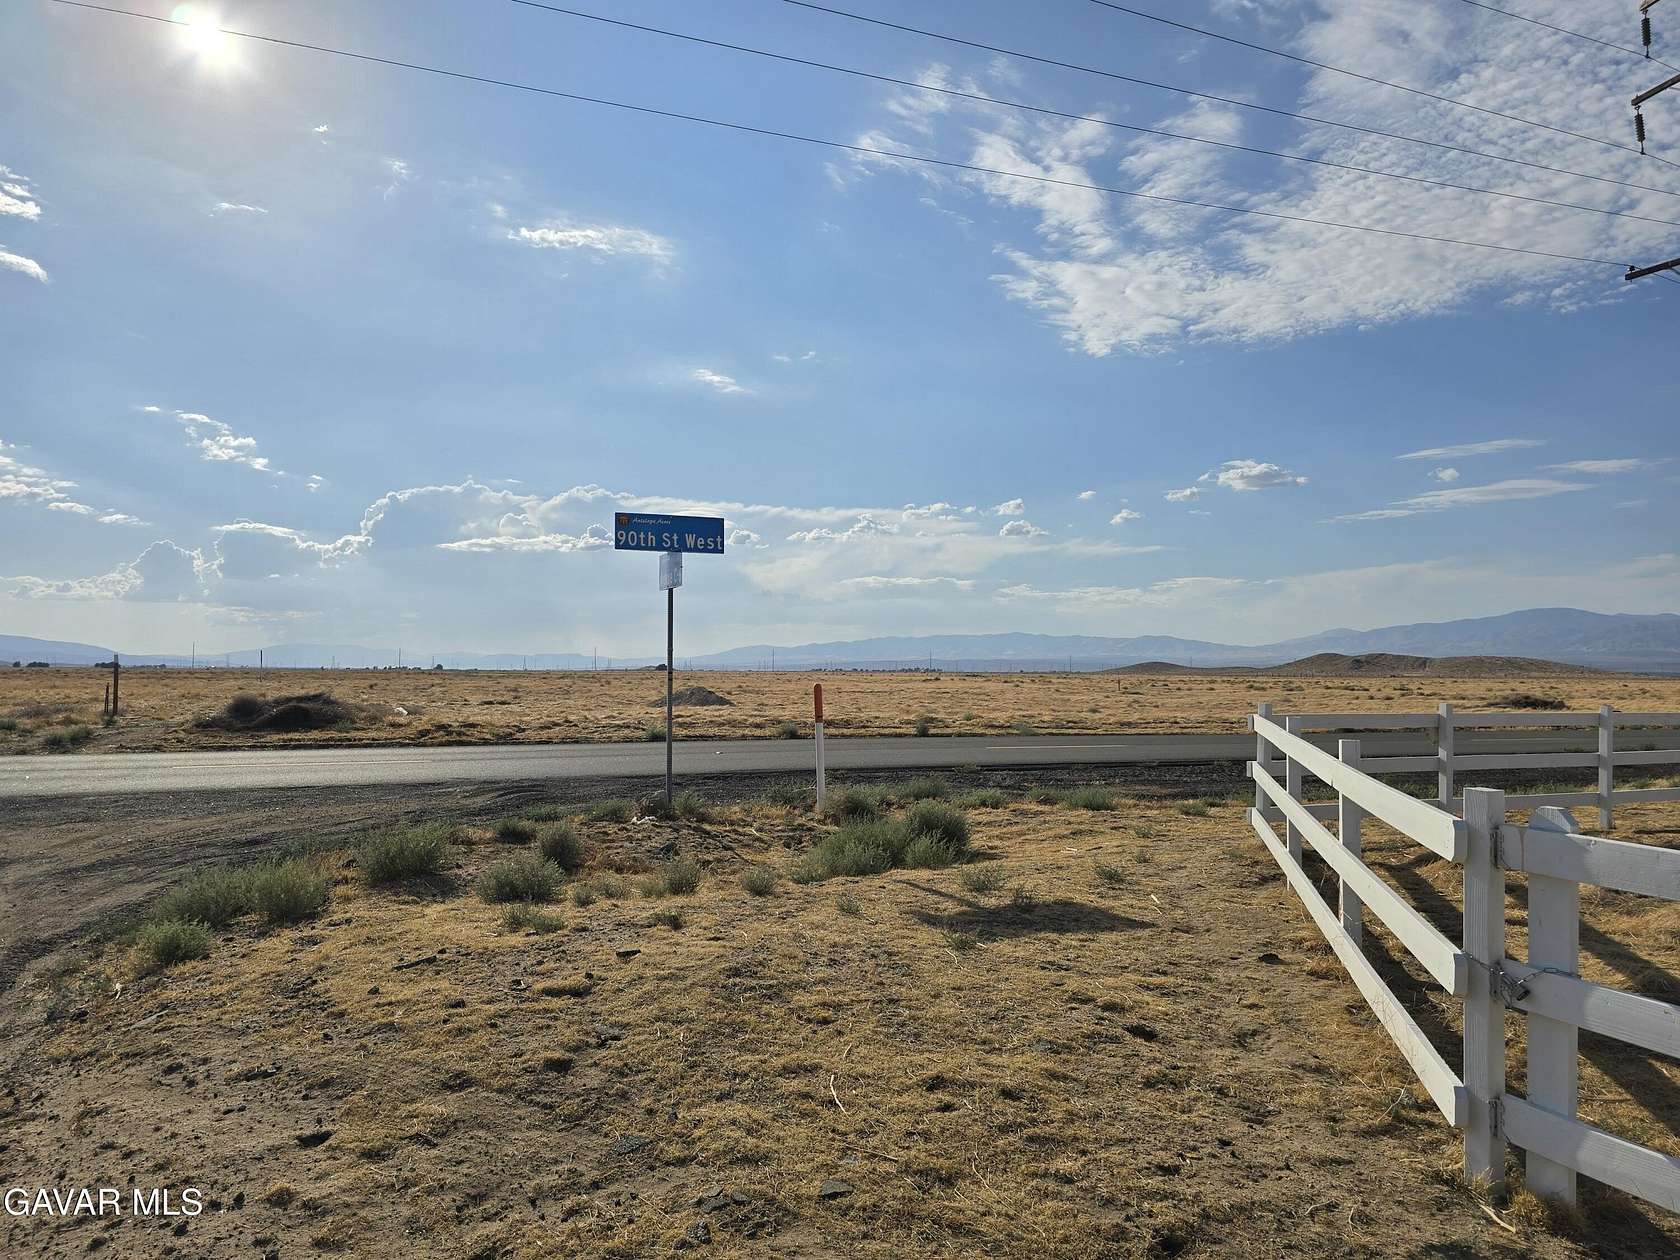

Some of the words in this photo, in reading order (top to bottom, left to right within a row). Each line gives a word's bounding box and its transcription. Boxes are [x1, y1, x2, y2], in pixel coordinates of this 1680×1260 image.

[617, 530, 656, 547] 90th
[662, 533, 679, 548] St
[685, 533, 722, 550] West
